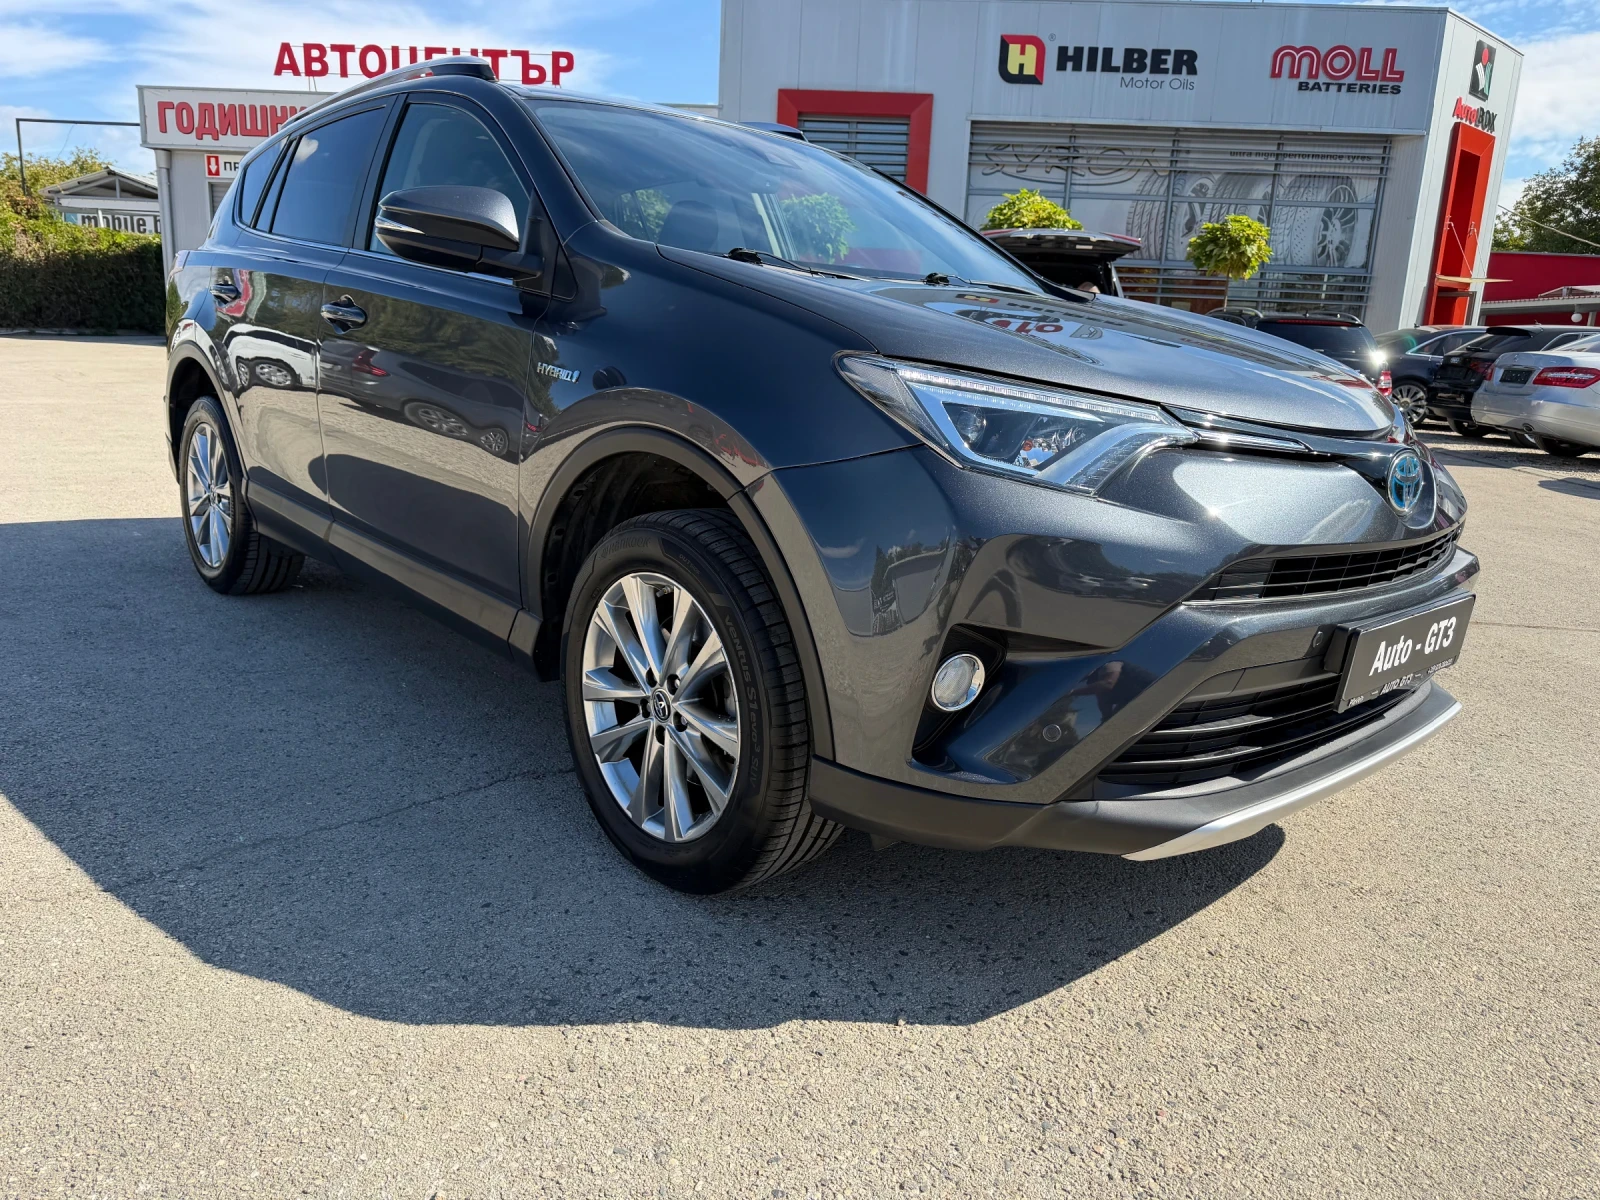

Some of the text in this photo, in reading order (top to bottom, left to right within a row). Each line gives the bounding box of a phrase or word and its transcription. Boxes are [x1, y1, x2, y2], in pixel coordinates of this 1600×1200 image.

[273, 42, 575, 86] АВТОЦТЪР
[1056, 45, 1199, 76] HILBER
[1119, 76, 1196, 91] Motor Oils
[1297, 81, 1402, 95] BATTERIES
[157, 100, 308, 141] ГОДИШН
[536, 361, 573, 382] HYBRID
[1368, 635, 1413, 677] Auto
[1424, 616, 1457, 655] GT3
